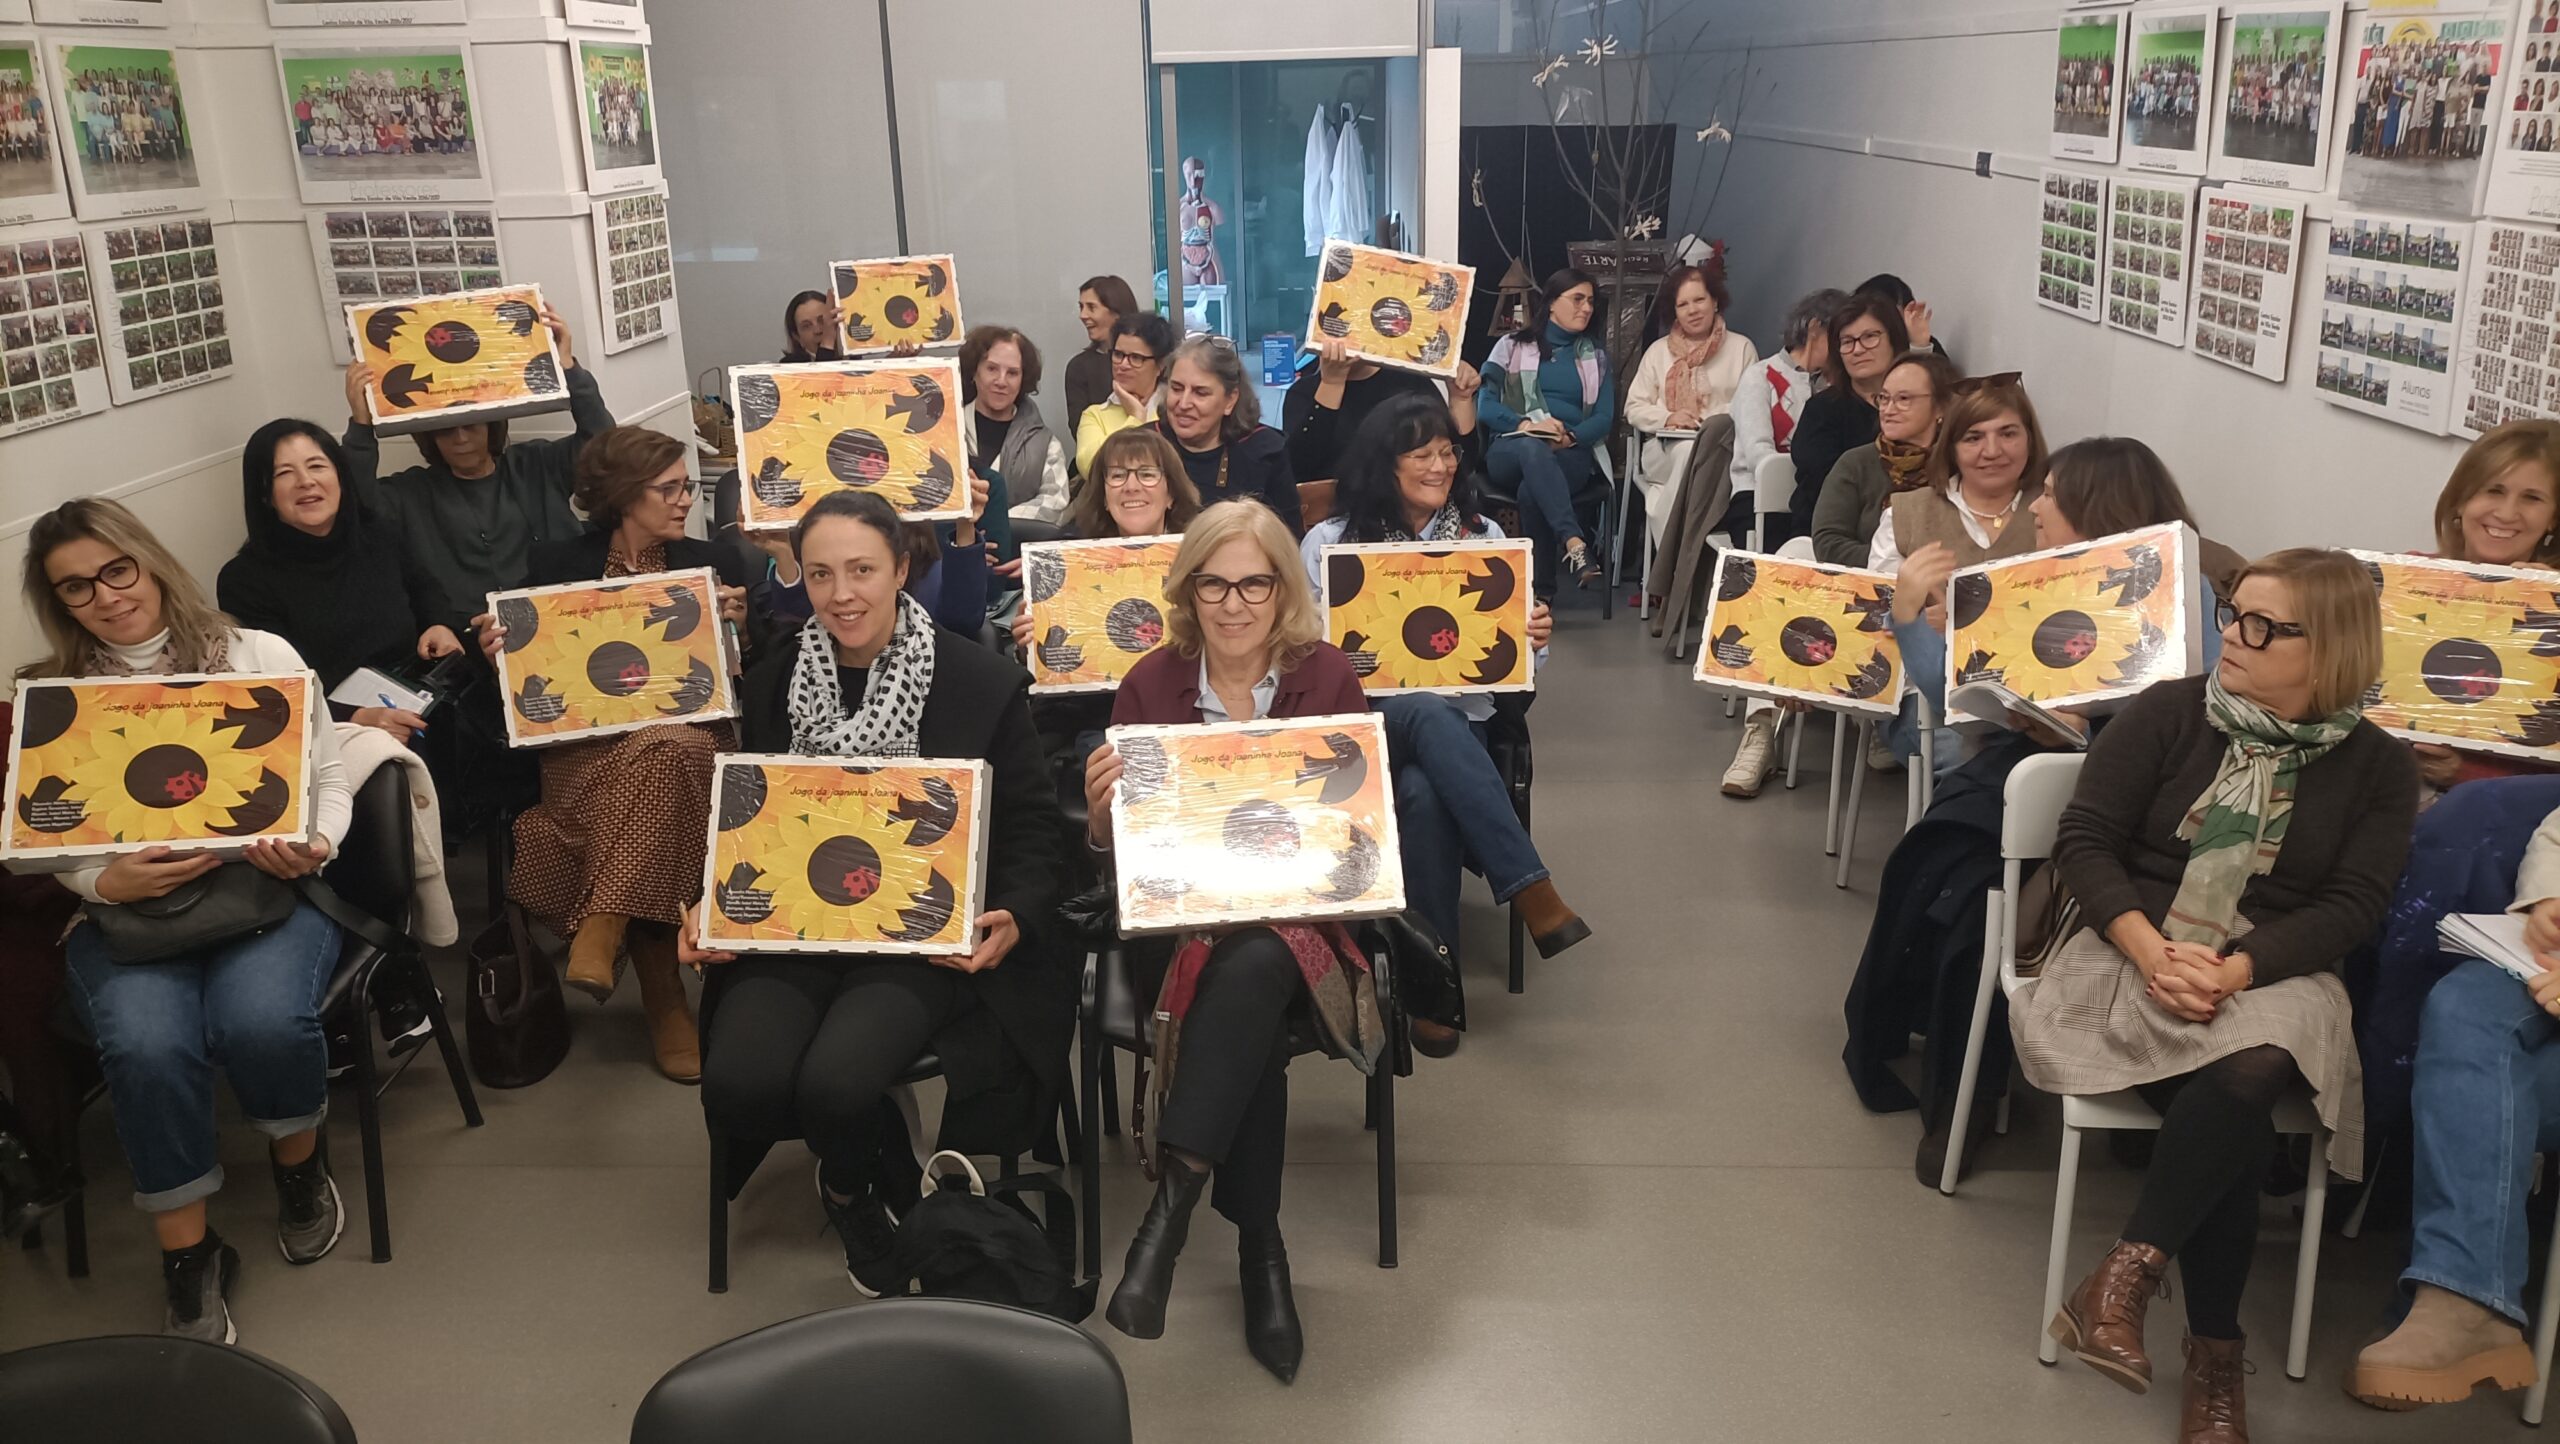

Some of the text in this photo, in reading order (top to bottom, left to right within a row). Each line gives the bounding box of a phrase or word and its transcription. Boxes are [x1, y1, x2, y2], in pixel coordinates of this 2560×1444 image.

[800, 389, 820, 400] Jogo
[822, 390, 832, 398] da
[2401, 381, 2431, 399] Alunos
[1382, 568, 1401, 577] Jogo
[1402, 568, 1412, 576] da
[1413, 568, 1444, 578] joaninha
[1773, 576, 1790, 586] Jogo
[2011, 579, 2033, 590] Jogo
[2495, 596, 2526, 606] Joana
[558, 600, 650, 617] Jogo da joaninha Joana
[102, 698, 224, 713] Jogo da joaninha Joana
[1191, 750, 1304, 765] Jogo da joaninha Joana
[790, 786, 898, 798] Jogo da joaninha Joana
